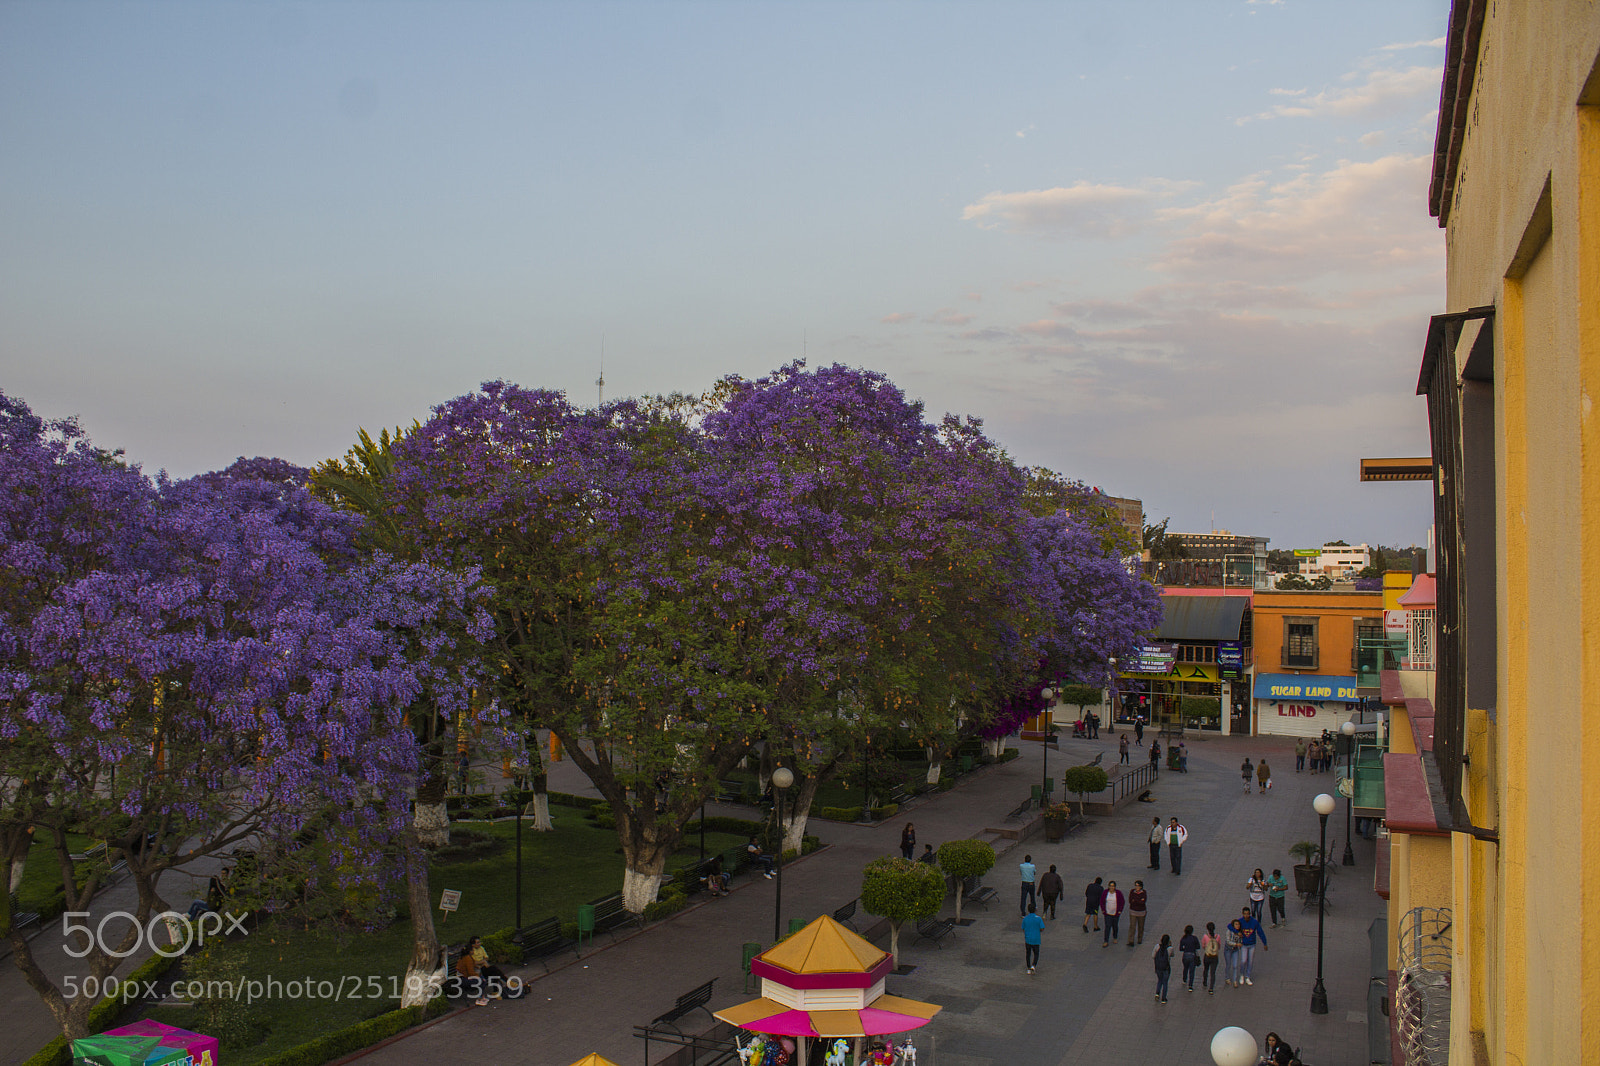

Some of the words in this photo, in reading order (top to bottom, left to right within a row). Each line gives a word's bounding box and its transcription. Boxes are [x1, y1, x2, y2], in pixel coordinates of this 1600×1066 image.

[1271, 686, 1301, 696] SUGAR
[1305, 687, 1331, 697] LAND
[1278, 704, 1316, 717] LAND
